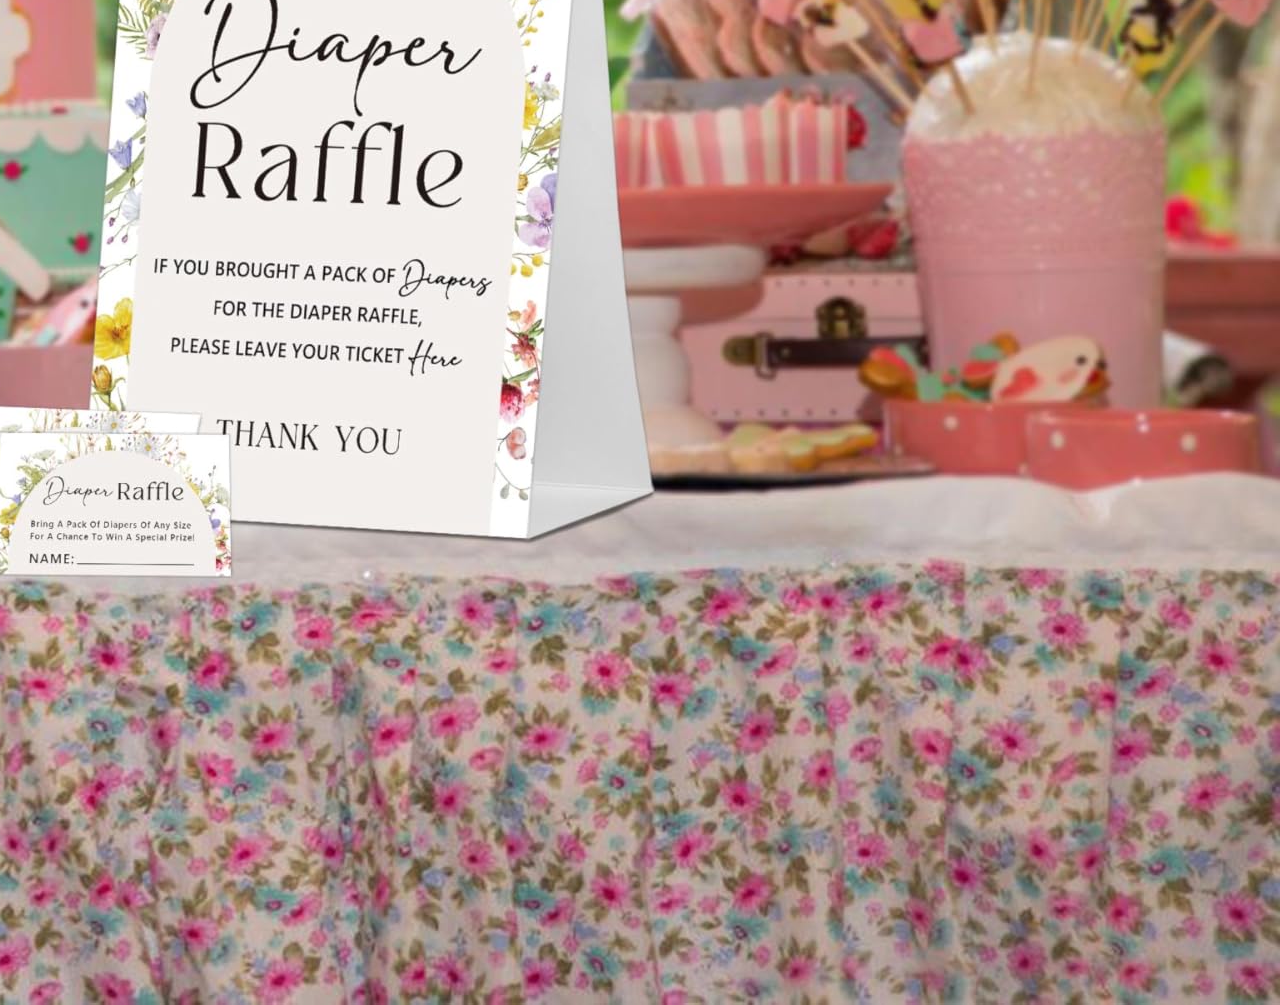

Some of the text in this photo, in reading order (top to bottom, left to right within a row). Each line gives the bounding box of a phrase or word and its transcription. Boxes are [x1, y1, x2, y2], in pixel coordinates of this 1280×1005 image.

[192, 120, 463, 208] Raffle
[154, 259, 492, 300] IF YOU BROUGHT A PACK OF Diapers
[214, 300, 422, 327] FOR THE DIAPER RAFFLE,
[171, 337, 462, 376] PLEASE LEAVE YOUR TICKET Here
[216, 419, 402, 455] THANK YOU
[42, 475, 185, 507] Diaper Raffle
[29, 532, 195, 544] For A Chance To Win A Special Prize!
[30, 519, 192, 531] Bring A Pack Of Diapers Of Any Size
